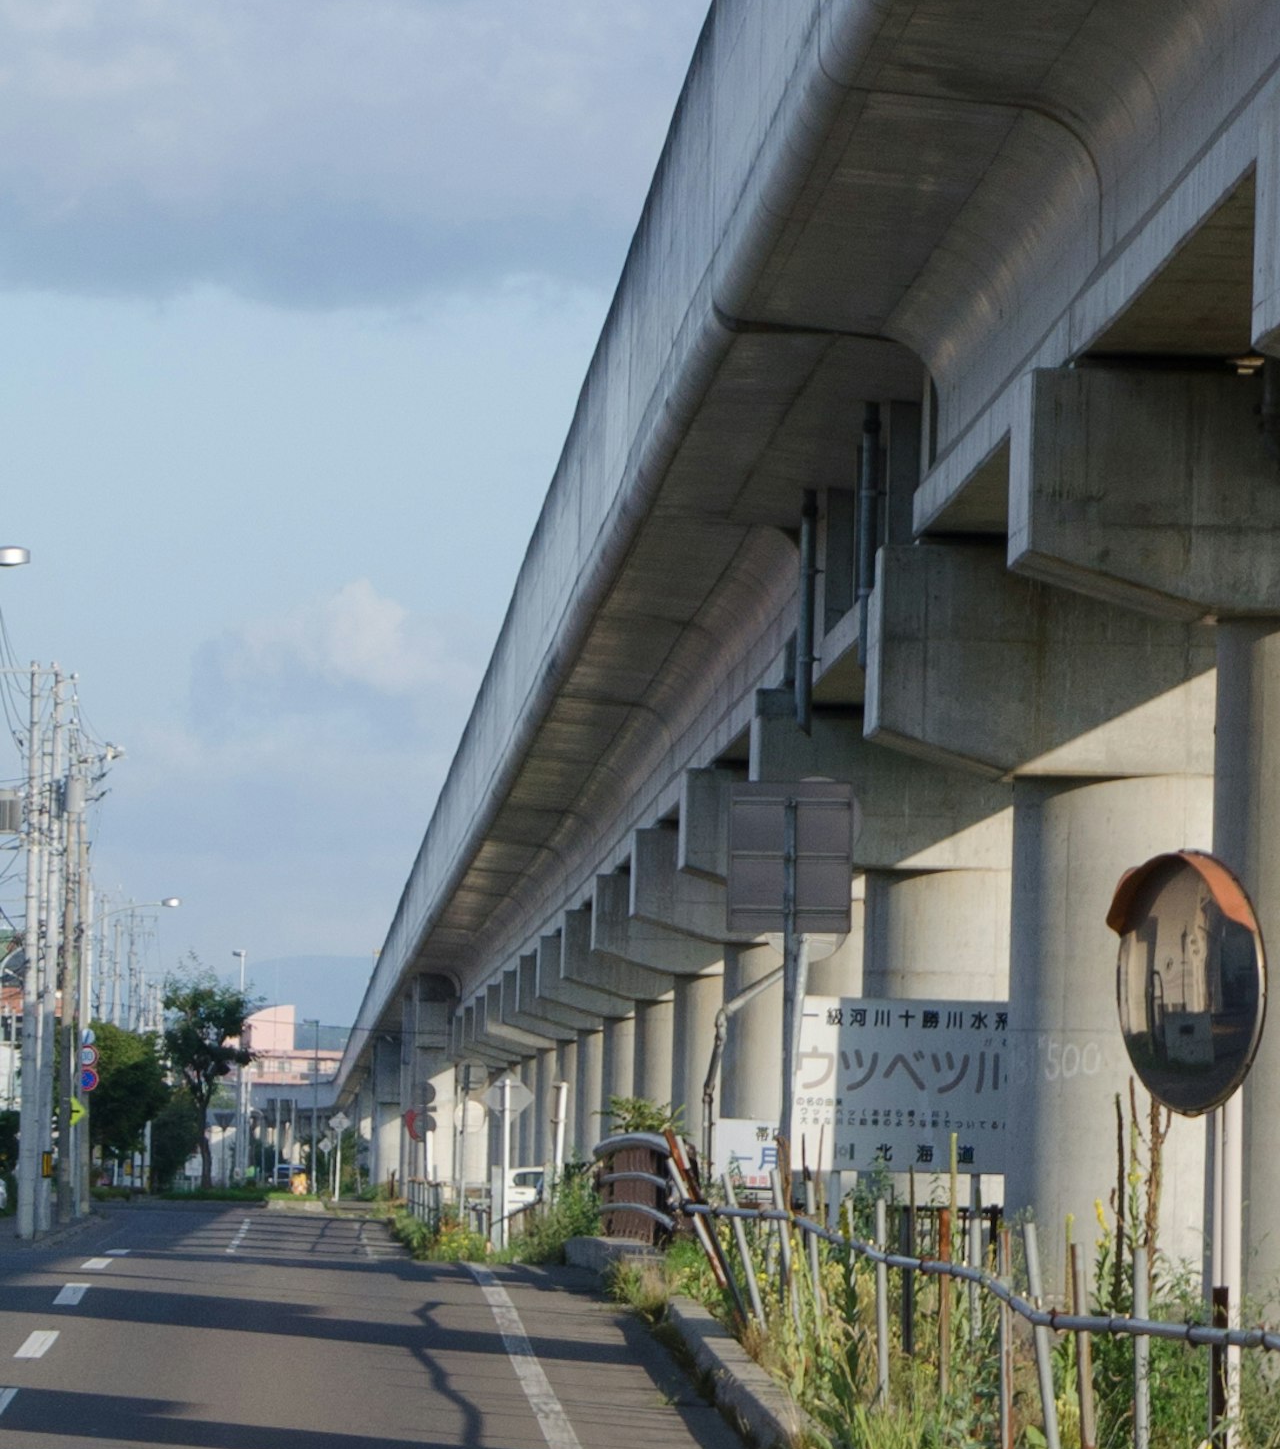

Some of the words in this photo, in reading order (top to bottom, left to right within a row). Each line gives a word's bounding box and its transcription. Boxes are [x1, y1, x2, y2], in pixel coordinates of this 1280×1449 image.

[802, 1007, 1008, 1031] 一級河川十勝川水系
